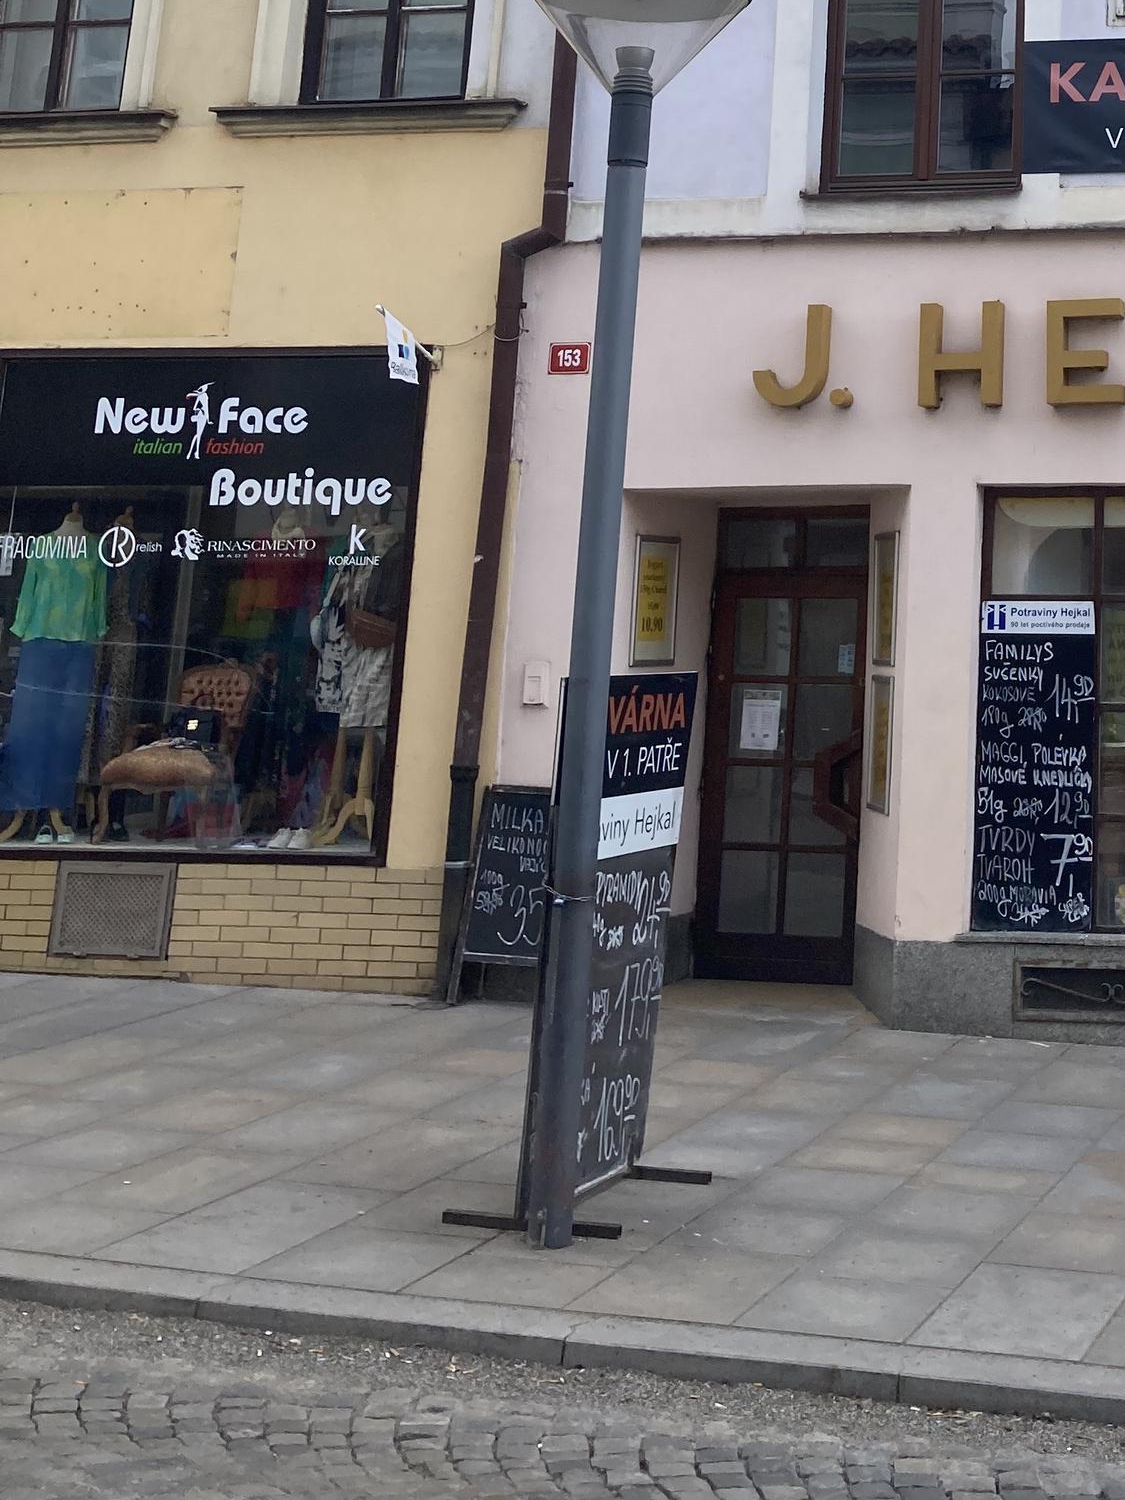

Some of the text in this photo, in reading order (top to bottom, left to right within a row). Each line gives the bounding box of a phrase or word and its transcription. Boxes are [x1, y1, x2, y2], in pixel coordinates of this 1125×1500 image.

[1105, 127, 1124, 149] v
[557, 348, 581, 367] 153
[752, 302, 855, 411] J.
[94, 396, 308, 434] New Face
[133, 438, 264, 455] italian fashion
[209, 467, 393, 516] Boutique
[136, 541, 163, 552] relish
[207, 539, 316, 552] RINASCIMENTO
[1010, 607, 1091, 619] Potraviny Hejkal
[1065, 621, 1090, 630] prodeje
[985, 639, 1054, 663] FAMILYS
[607, 737, 683, 779] V 1. PATŘE
[490, 802, 545, 836] MILKA
[634, 801, 677, 841] Hejkal
[977, 853, 1035, 884] TVAROH
